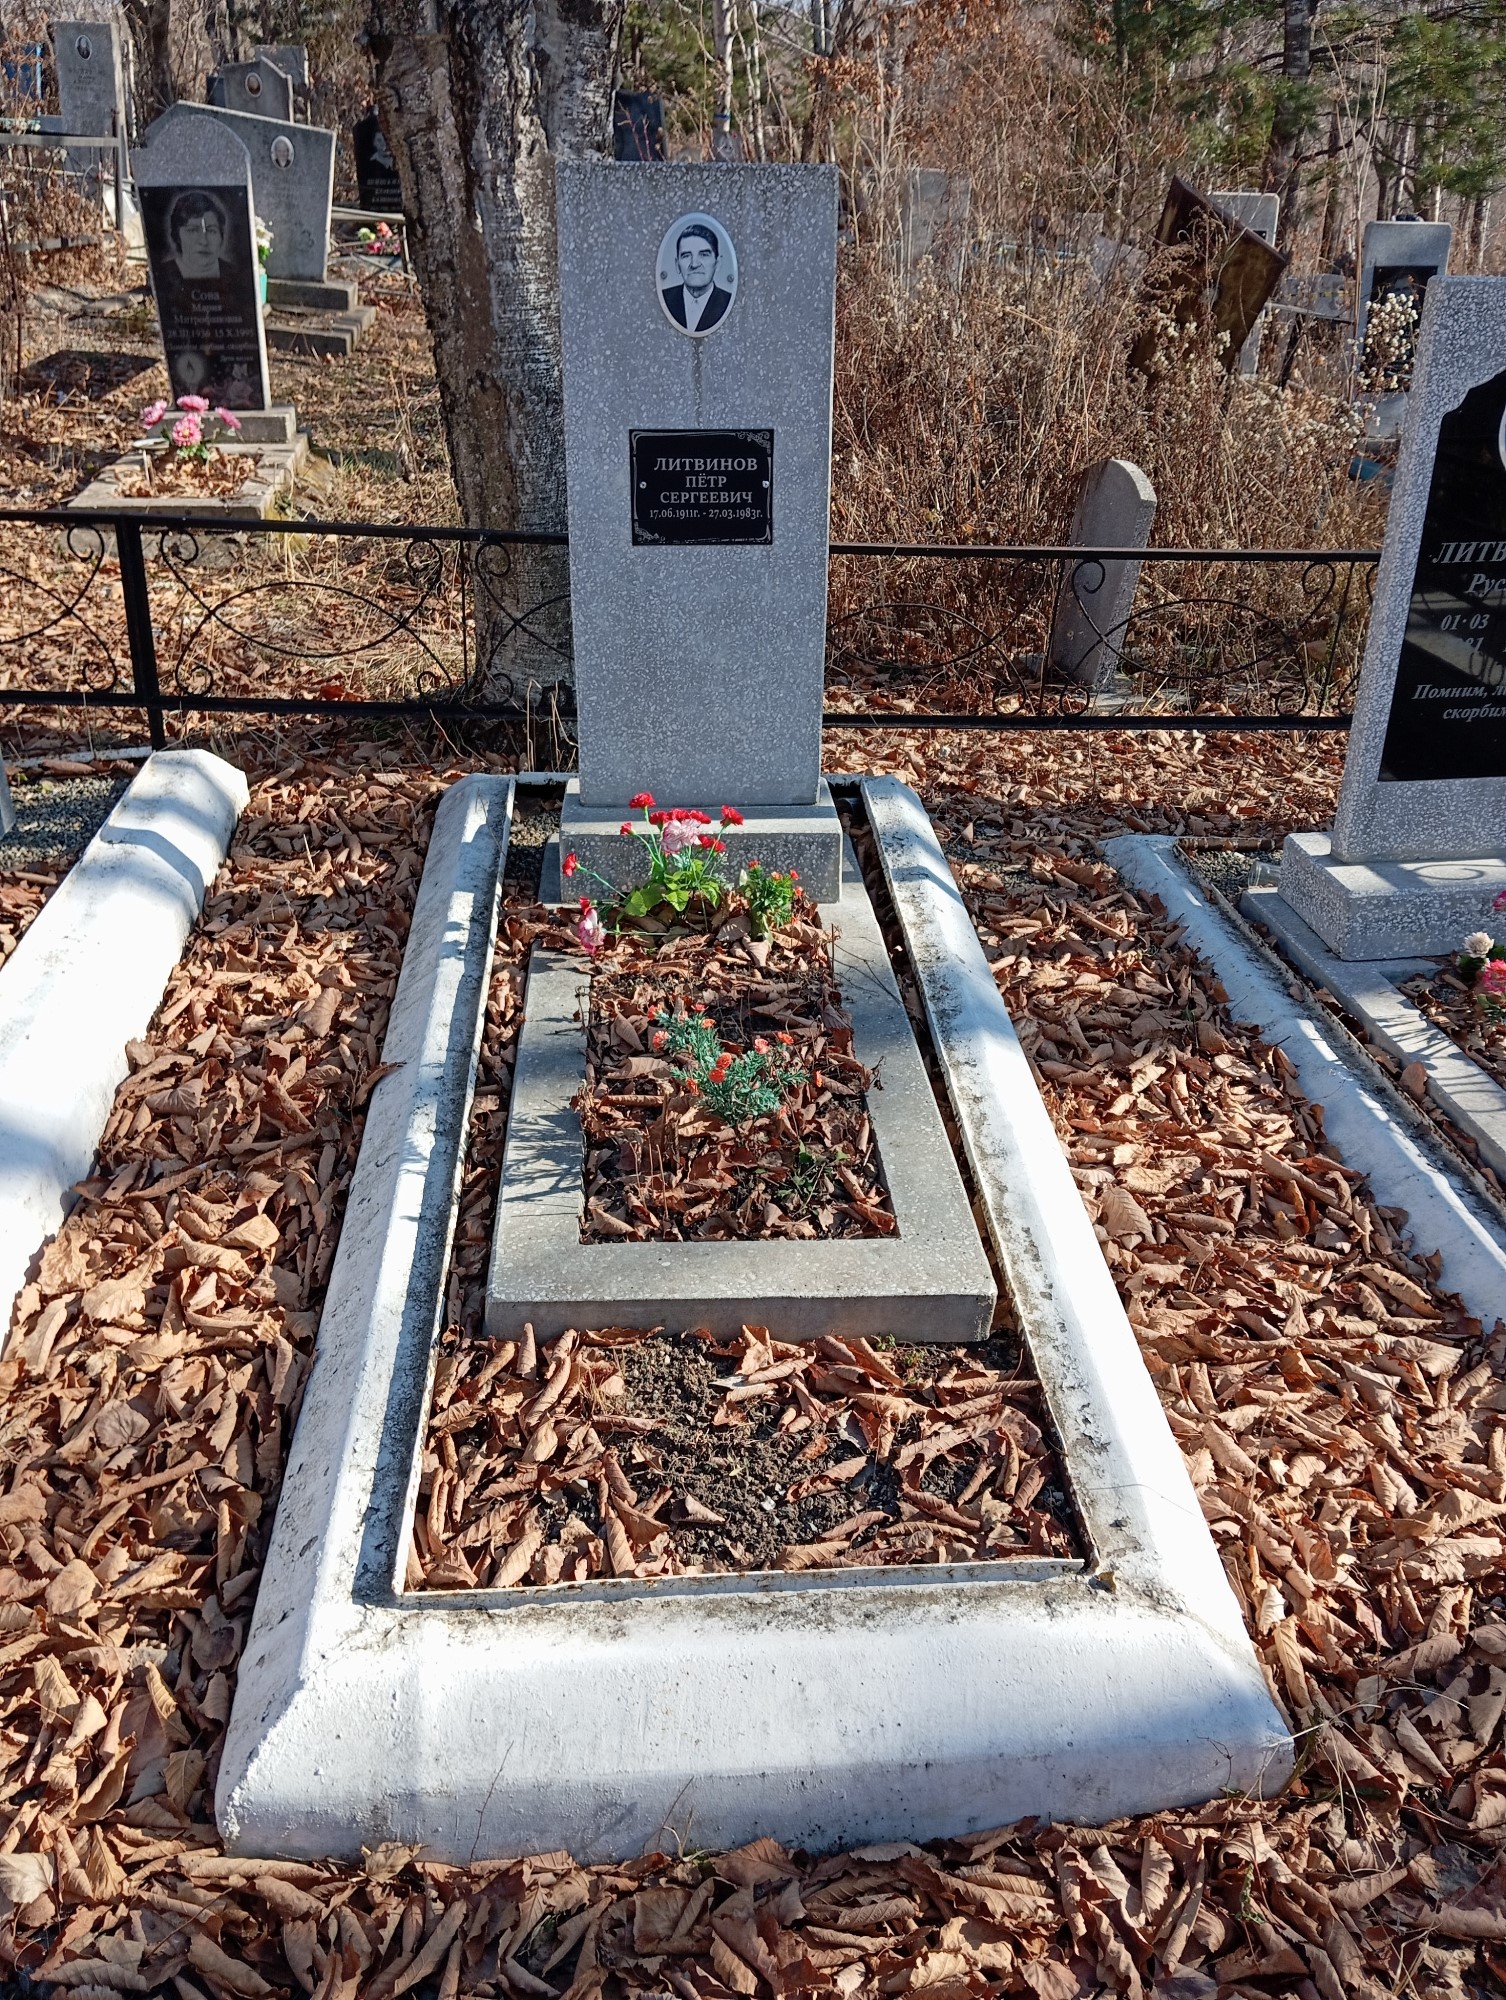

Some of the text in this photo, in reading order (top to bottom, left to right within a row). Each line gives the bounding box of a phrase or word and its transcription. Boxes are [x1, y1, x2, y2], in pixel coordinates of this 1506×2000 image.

[654, 457, 758, 471] ЛИТВИНОВ
[685, 473, 727, 488] ПЁТР
[660, 491, 753, 504] СЕРГЕЕВИЧ
[649, 507, 701, 520] 17.06.1911г.
[708, 507, 763, 520] 27.03.1983г.
[1464, 573, 1506, 598] Рус
[1411, 684, 1487, 699] Помним,
